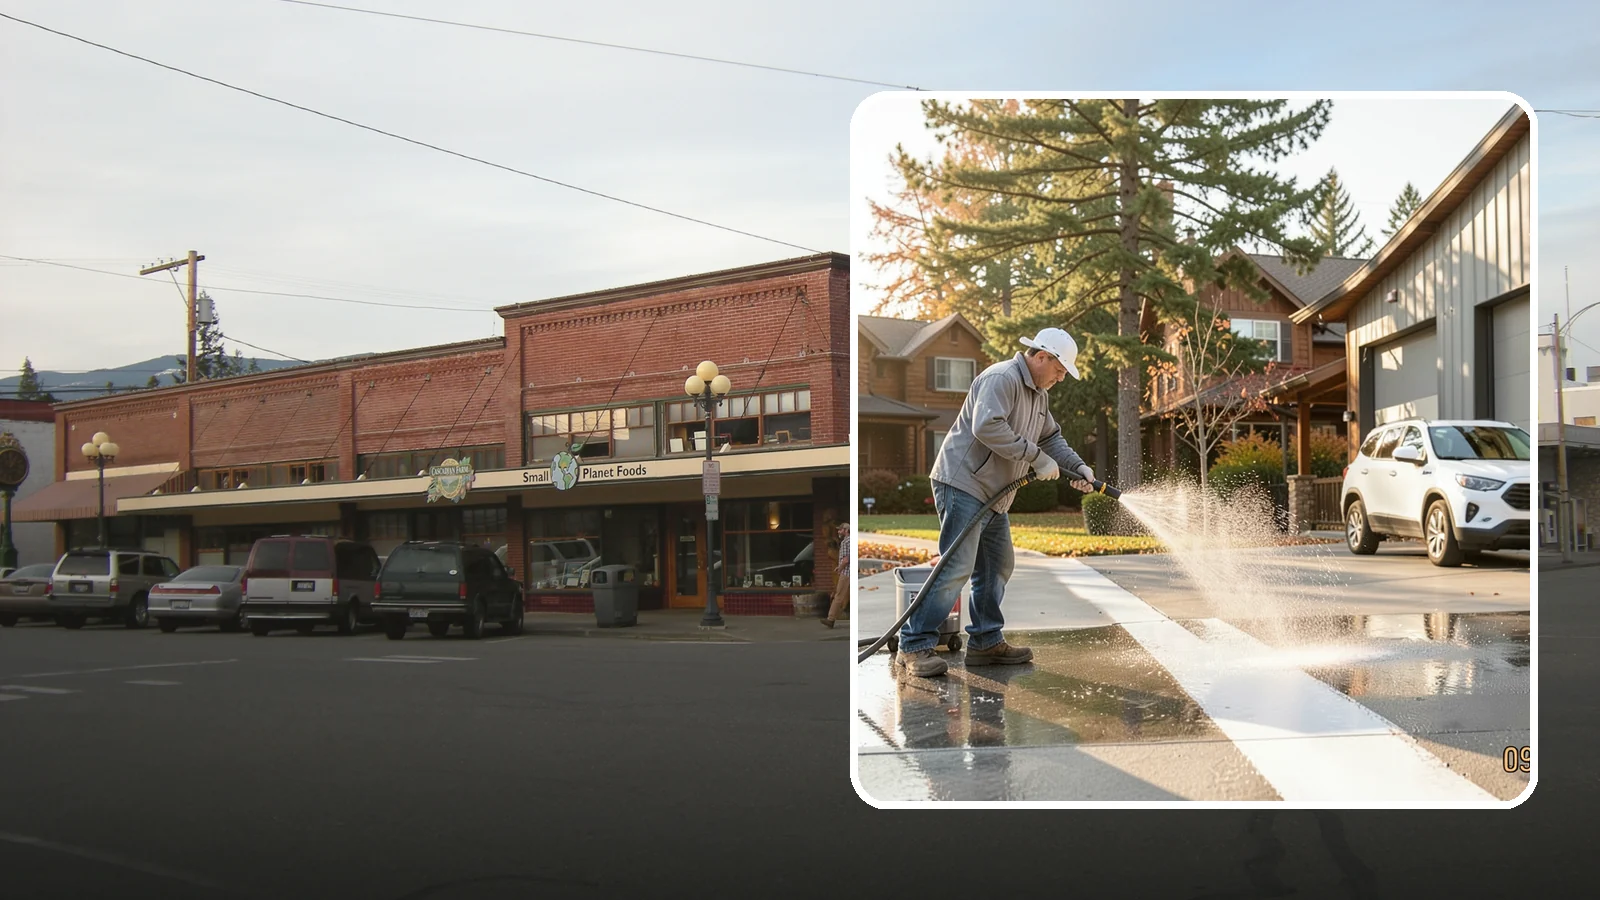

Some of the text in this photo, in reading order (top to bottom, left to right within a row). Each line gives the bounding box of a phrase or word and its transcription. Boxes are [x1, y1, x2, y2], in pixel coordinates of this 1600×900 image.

[523, 465, 647, 483] Small Planet Foods
